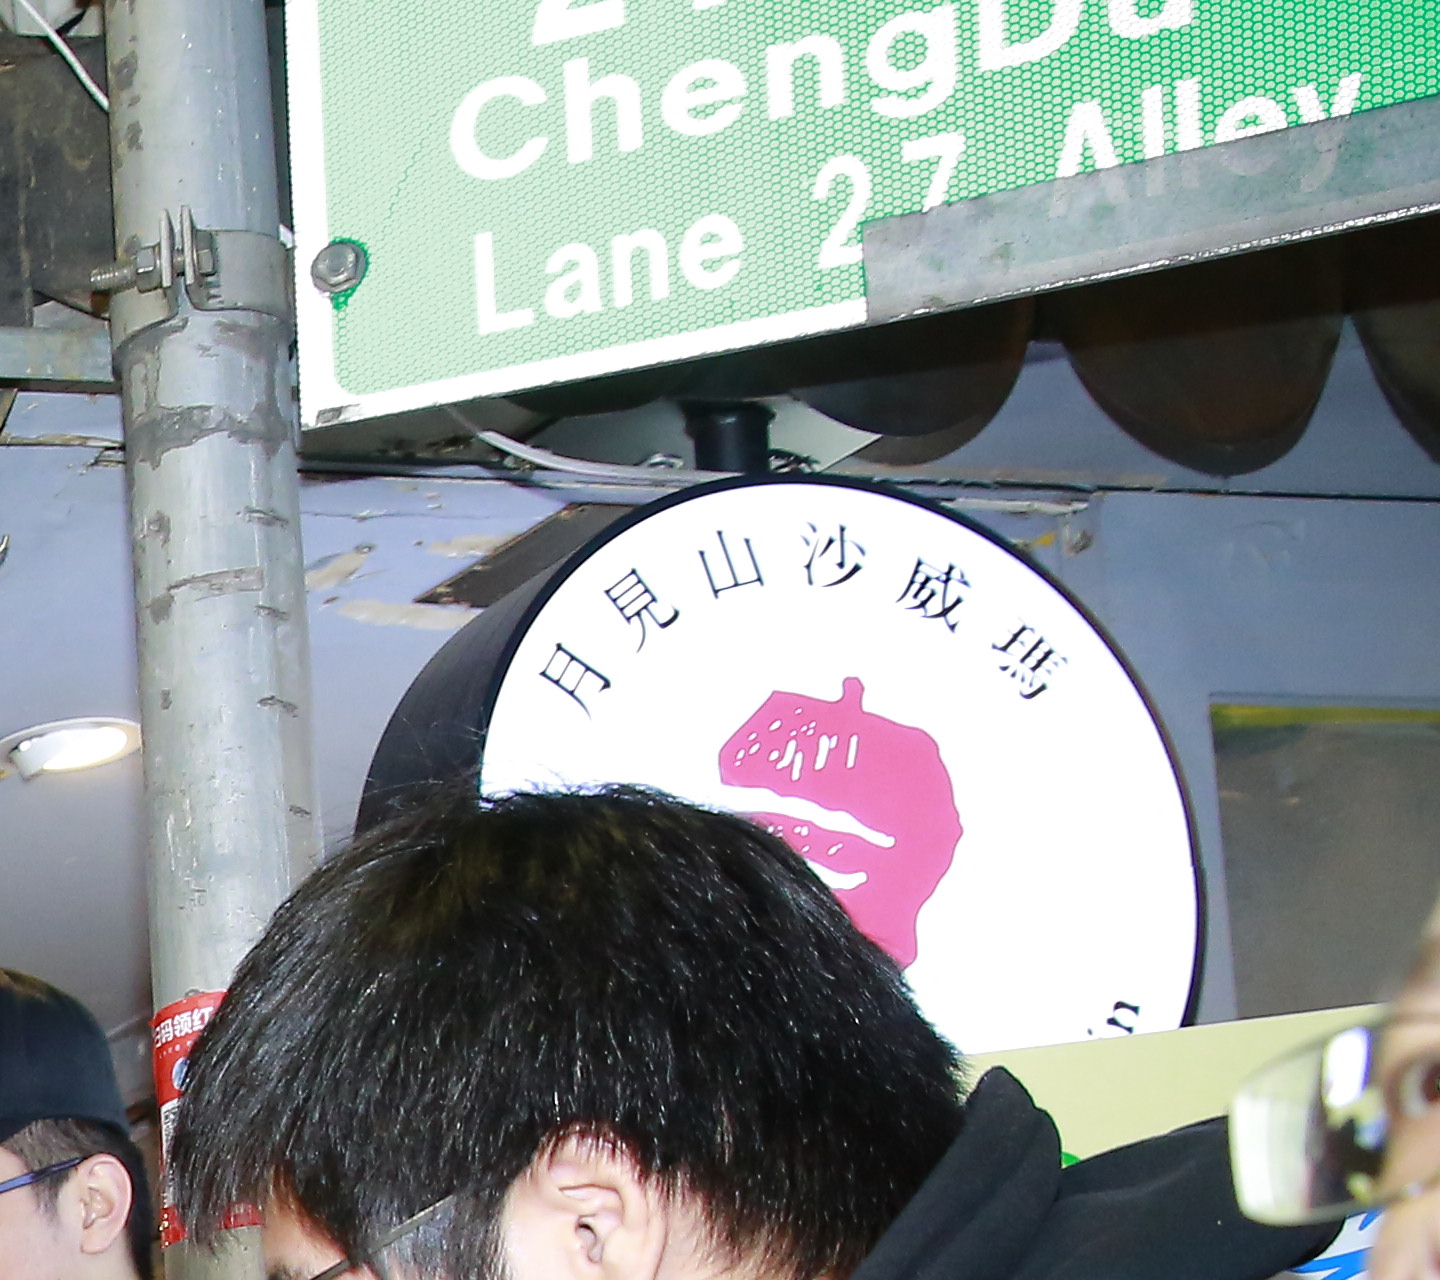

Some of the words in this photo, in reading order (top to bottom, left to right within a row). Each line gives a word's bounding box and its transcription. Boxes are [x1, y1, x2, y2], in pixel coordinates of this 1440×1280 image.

[474, 211, 744, 336] Lane
[812, 131, 967, 271] 27
[538, 521, 1070, 718] 月見山沙威瑪
